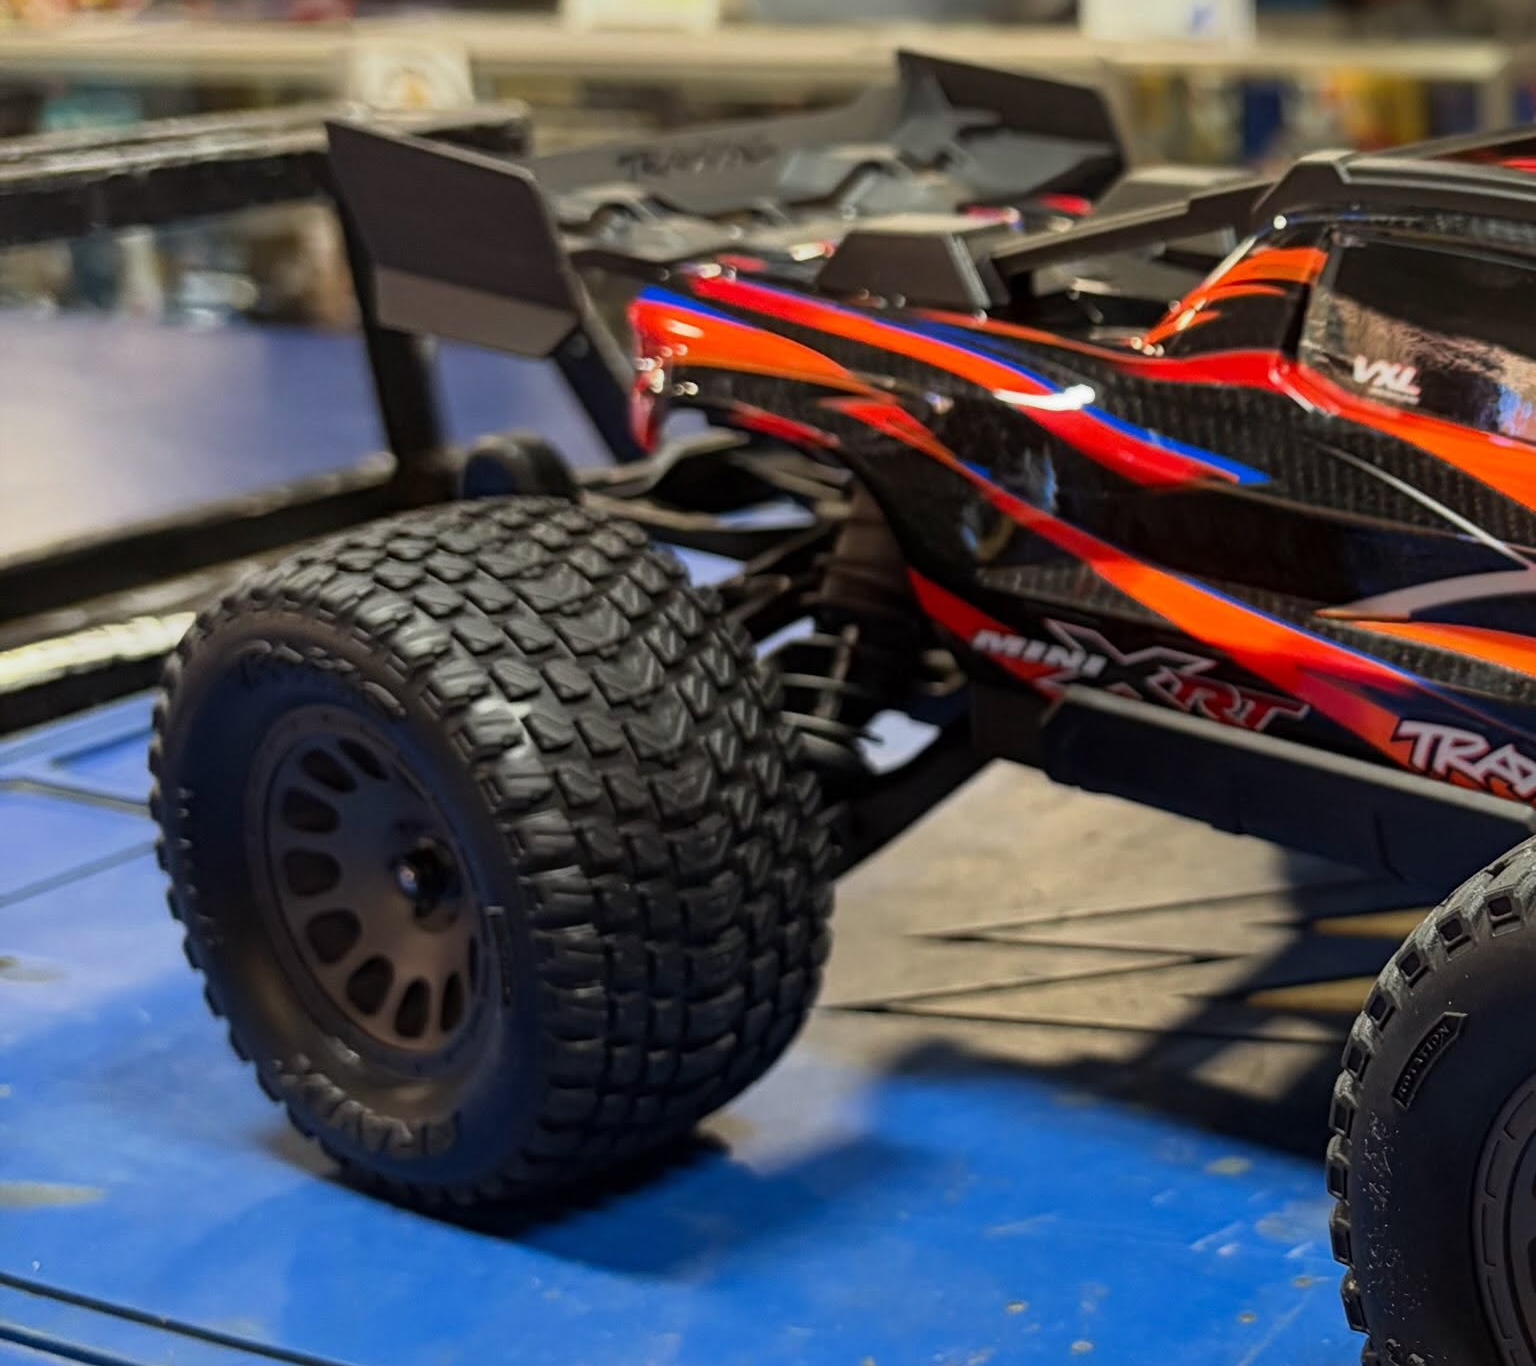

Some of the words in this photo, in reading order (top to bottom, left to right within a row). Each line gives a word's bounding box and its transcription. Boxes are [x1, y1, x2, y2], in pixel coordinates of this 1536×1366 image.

[1353, 354, 1421, 395] VXL
[972, 629, 1107, 677] MINI
[1035, 618, 1310, 732] XRT
